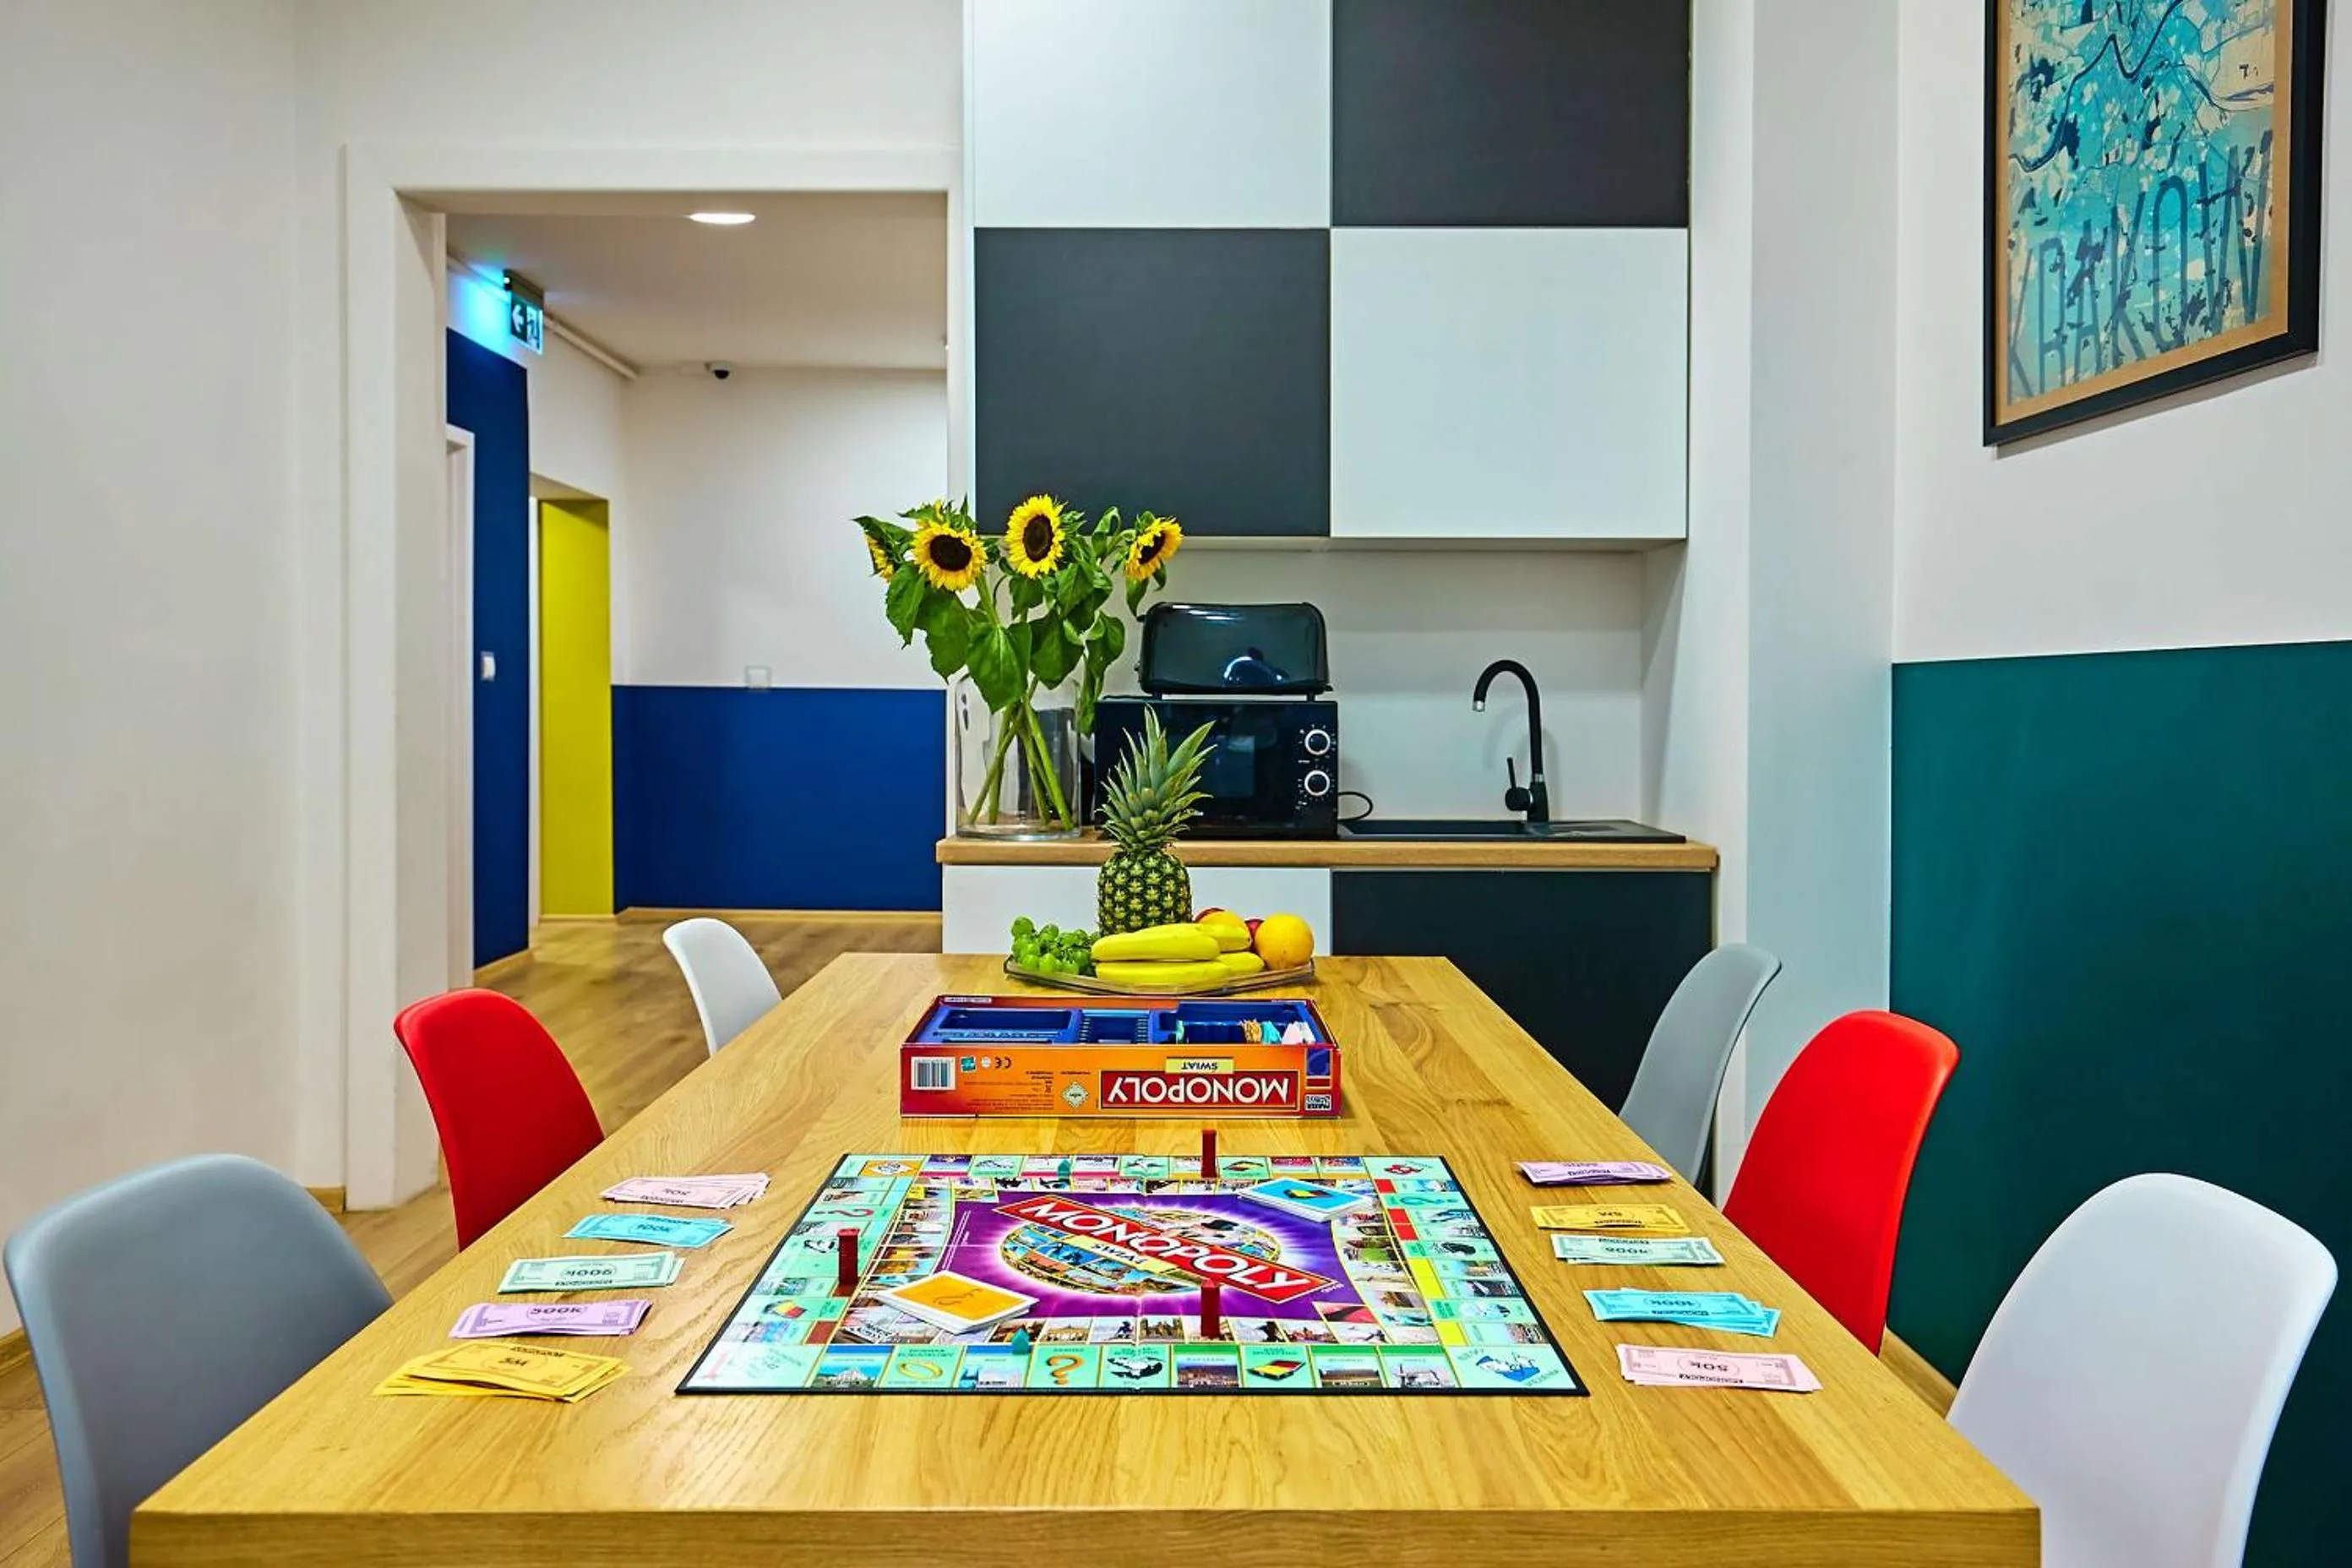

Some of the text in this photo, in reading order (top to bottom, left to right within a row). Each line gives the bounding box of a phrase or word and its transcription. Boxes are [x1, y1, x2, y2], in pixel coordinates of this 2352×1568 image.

[1108, 1077, 1289, 1103] MONOPOLY
[1021, 1202, 1309, 1288] MONOPOLY
[1047, 1354, 1085, 1385] ?
